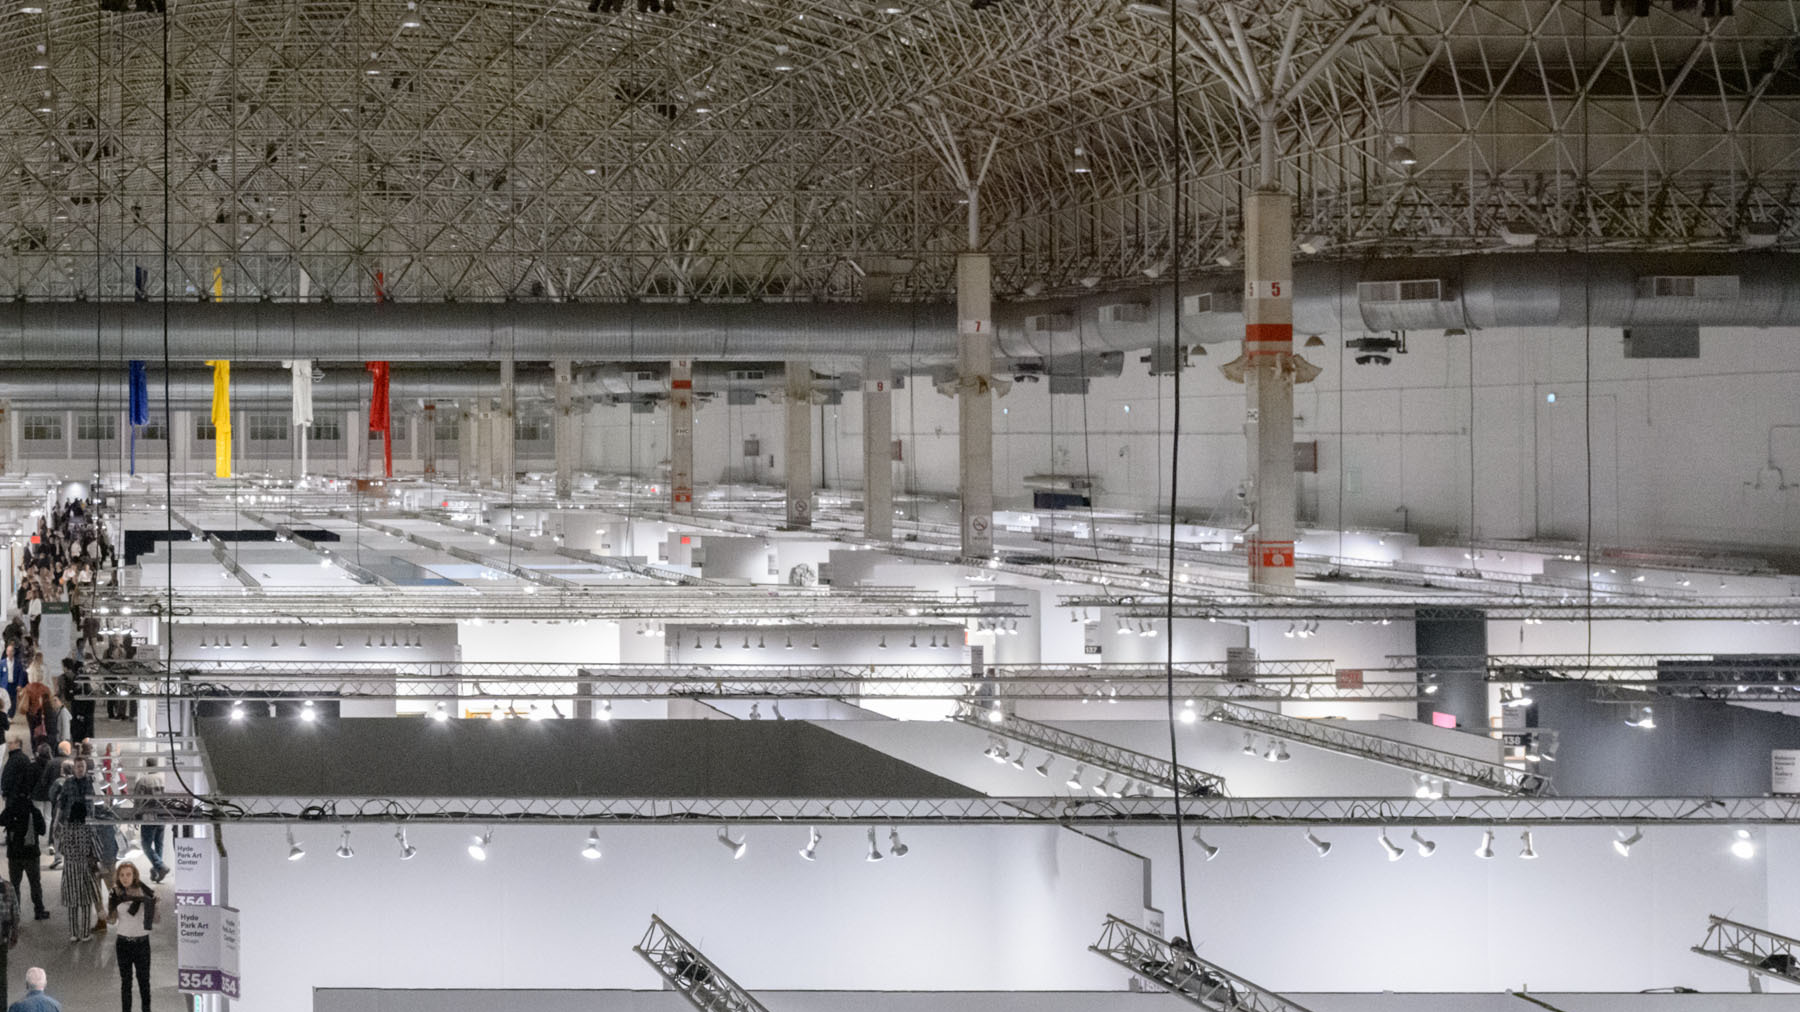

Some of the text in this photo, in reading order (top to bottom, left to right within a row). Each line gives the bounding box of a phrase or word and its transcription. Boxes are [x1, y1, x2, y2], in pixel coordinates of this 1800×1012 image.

[1271, 282, 1281, 297] 5
[975, 320, 982, 332] 7
[176, 896, 206, 905] 354
[180, 913, 199, 921] Hyde
[180, 921, 196, 929] Park
[180, 929, 205, 937] Center
[180, 972, 214, 988] 354
